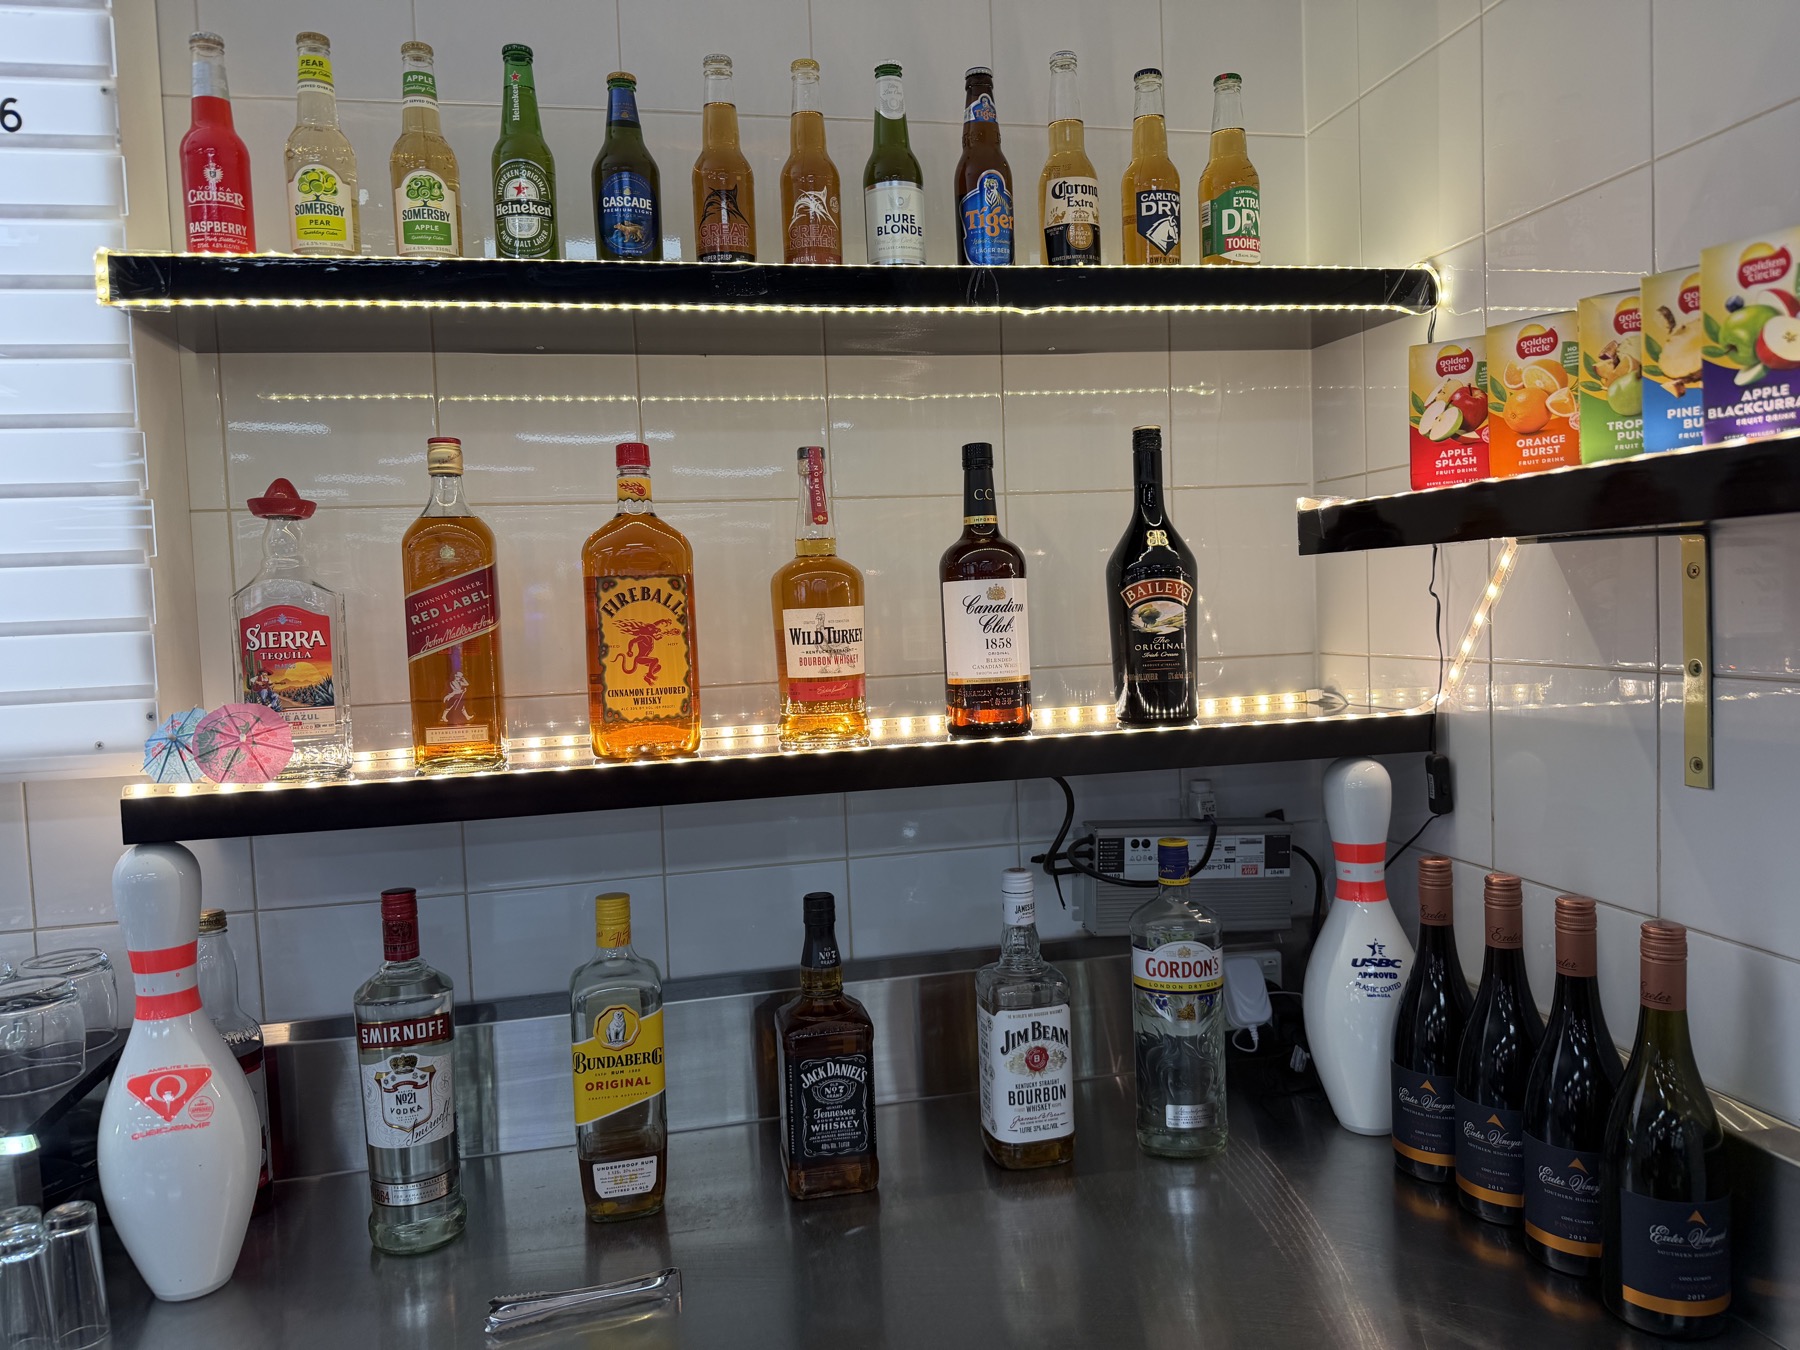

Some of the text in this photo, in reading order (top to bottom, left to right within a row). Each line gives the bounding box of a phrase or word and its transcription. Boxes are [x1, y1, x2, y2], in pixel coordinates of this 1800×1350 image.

[301, 60, 324, 68] PEAR
[407, 75, 433, 84] APPLE
[512, 84, 521, 121] Heineken
[0, 97, 22, 132] 6
[974, 108, 996, 121] Tiger
[497, 169, 520, 196] HEINEKEN
[521, 169, 548, 196] ORIGINAL
[1051, 180, 1099, 201] Corona
[1140, 192, 1180, 202] CARLTON
[188, 189, 246, 208] CRUISER
[602, 196, 653, 211] CASCADE
[1067, 196, 1094, 208] Extra
[1233, 196, 1260, 210] EXTRA
[295, 203, 345, 217] SOMERSBY
[402, 208, 450, 222] SOMERSBY
[495, 202, 552, 217] Heineken
[634, 208, 653, 216] LIGHT
[1140, 201, 1180, 217] DRY
[885, 213, 916, 224] PURE
[965, 206, 1014, 237] Tiger
[1221, 208, 1261, 237] DRY
[189, 220, 248, 237] RASPBERRY
[415, 224, 440, 232] APPLE
[700, 223, 749, 238] GREAT
[789, 224, 837, 240] GREAT
[877, 224, 923, 237] BLONDE
[500, 229, 513, 245] PURE
[533, 230, 549, 246] LAGER
[701, 236, 750, 249] NORTHERN
[789, 237, 838, 250] NORTHERN
[1226, 238, 1261, 251] TOOHEYS
[717, 254, 733, 262] CRISP
[1741, 257, 1787, 277] golden
[1746, 268, 1783, 283] circle
[1520, 336, 1555, 350] golden
[1524, 344, 1551, 355] circle
[1439, 356, 1470, 367] golden
[1442, 364, 1467, 373] circle
[1741, 383, 1790, 402] APPLE
[1735, 414, 1764, 426] FRUIT
[1516, 434, 1566, 448] ORANGE
[1614, 443, 1639, 451] FRUIT
[1439, 447, 1473, 458] APPLE
[1521, 445, 1561, 458] BURST
[1435, 456, 1478, 468] SPLASH
[1518, 456, 1565, 467] FRUIT DRINK
[1435, 468, 1455, 476] FRUIT
[813, 465, 823, 507] BOURBON
[414, 581, 482, 612] JOHNNIE WALKER
[1126, 582, 1190, 602] BAILEYS
[410, 590, 490, 626] RED LABEL
[601, 586, 684, 619] FIREBALL
[962, 594, 1024, 615] Canadian
[411, 622, 439, 636] BLENDED
[441, 612, 465, 624] SCOTCH
[245, 623, 328, 653] SIERRA
[788, 626, 863, 646] WILD TURKEY
[1152, 636, 1171, 644] The
[985, 637, 1012, 650] 1858
[1134, 642, 1186, 651] ORIGINAL
[260, 650, 312, 661] TEQUILA
[799, 653, 859, 667] BOURBON WHISKEY
[607, 685, 687, 698] CINNAMON FLAVOURED
[633, 696, 663, 706] WHISKY
[294, 712, 320, 722] AZUL
[1145, 956, 1219, 978] GORDON'S
[1351, 957, 1402, 969] USBC
[1357, 971, 1398, 979] APPROVED
[1148, 982, 1183, 990] LONDON
[1355, 981, 1402, 993] PLASTIC COATED
[361, 1018, 445, 1045] SMIRNOFF
[1000, 1020, 1069, 1056] JIM BEAM
[572, 1046, 663, 1074] BUNDABERG
[801, 1060, 868, 1089] JACK DANIEL'S
[585, 1076, 652, 1092] ORIGINAL
[1015, 1078, 1060, 1090] KENTUCKY STRAIGHT
[1008, 1083, 1067, 1106] BOURBON
[389, 1105, 423, 1116] VODKA
[813, 1107, 857, 1120] Tennessee
[1025, 1102, 1052, 1113] WHISKEY
[810, 1119, 861, 1133] WHISKEY
[1420, 1144, 1437, 1152] 2019
[596, 1161, 639, 1172] UNDERPROOF
[1487, 1183, 1504, 1191] 2019
[1568, 1233, 1587, 1241] 2019
[1687, 1293, 1706, 1301] 2019
